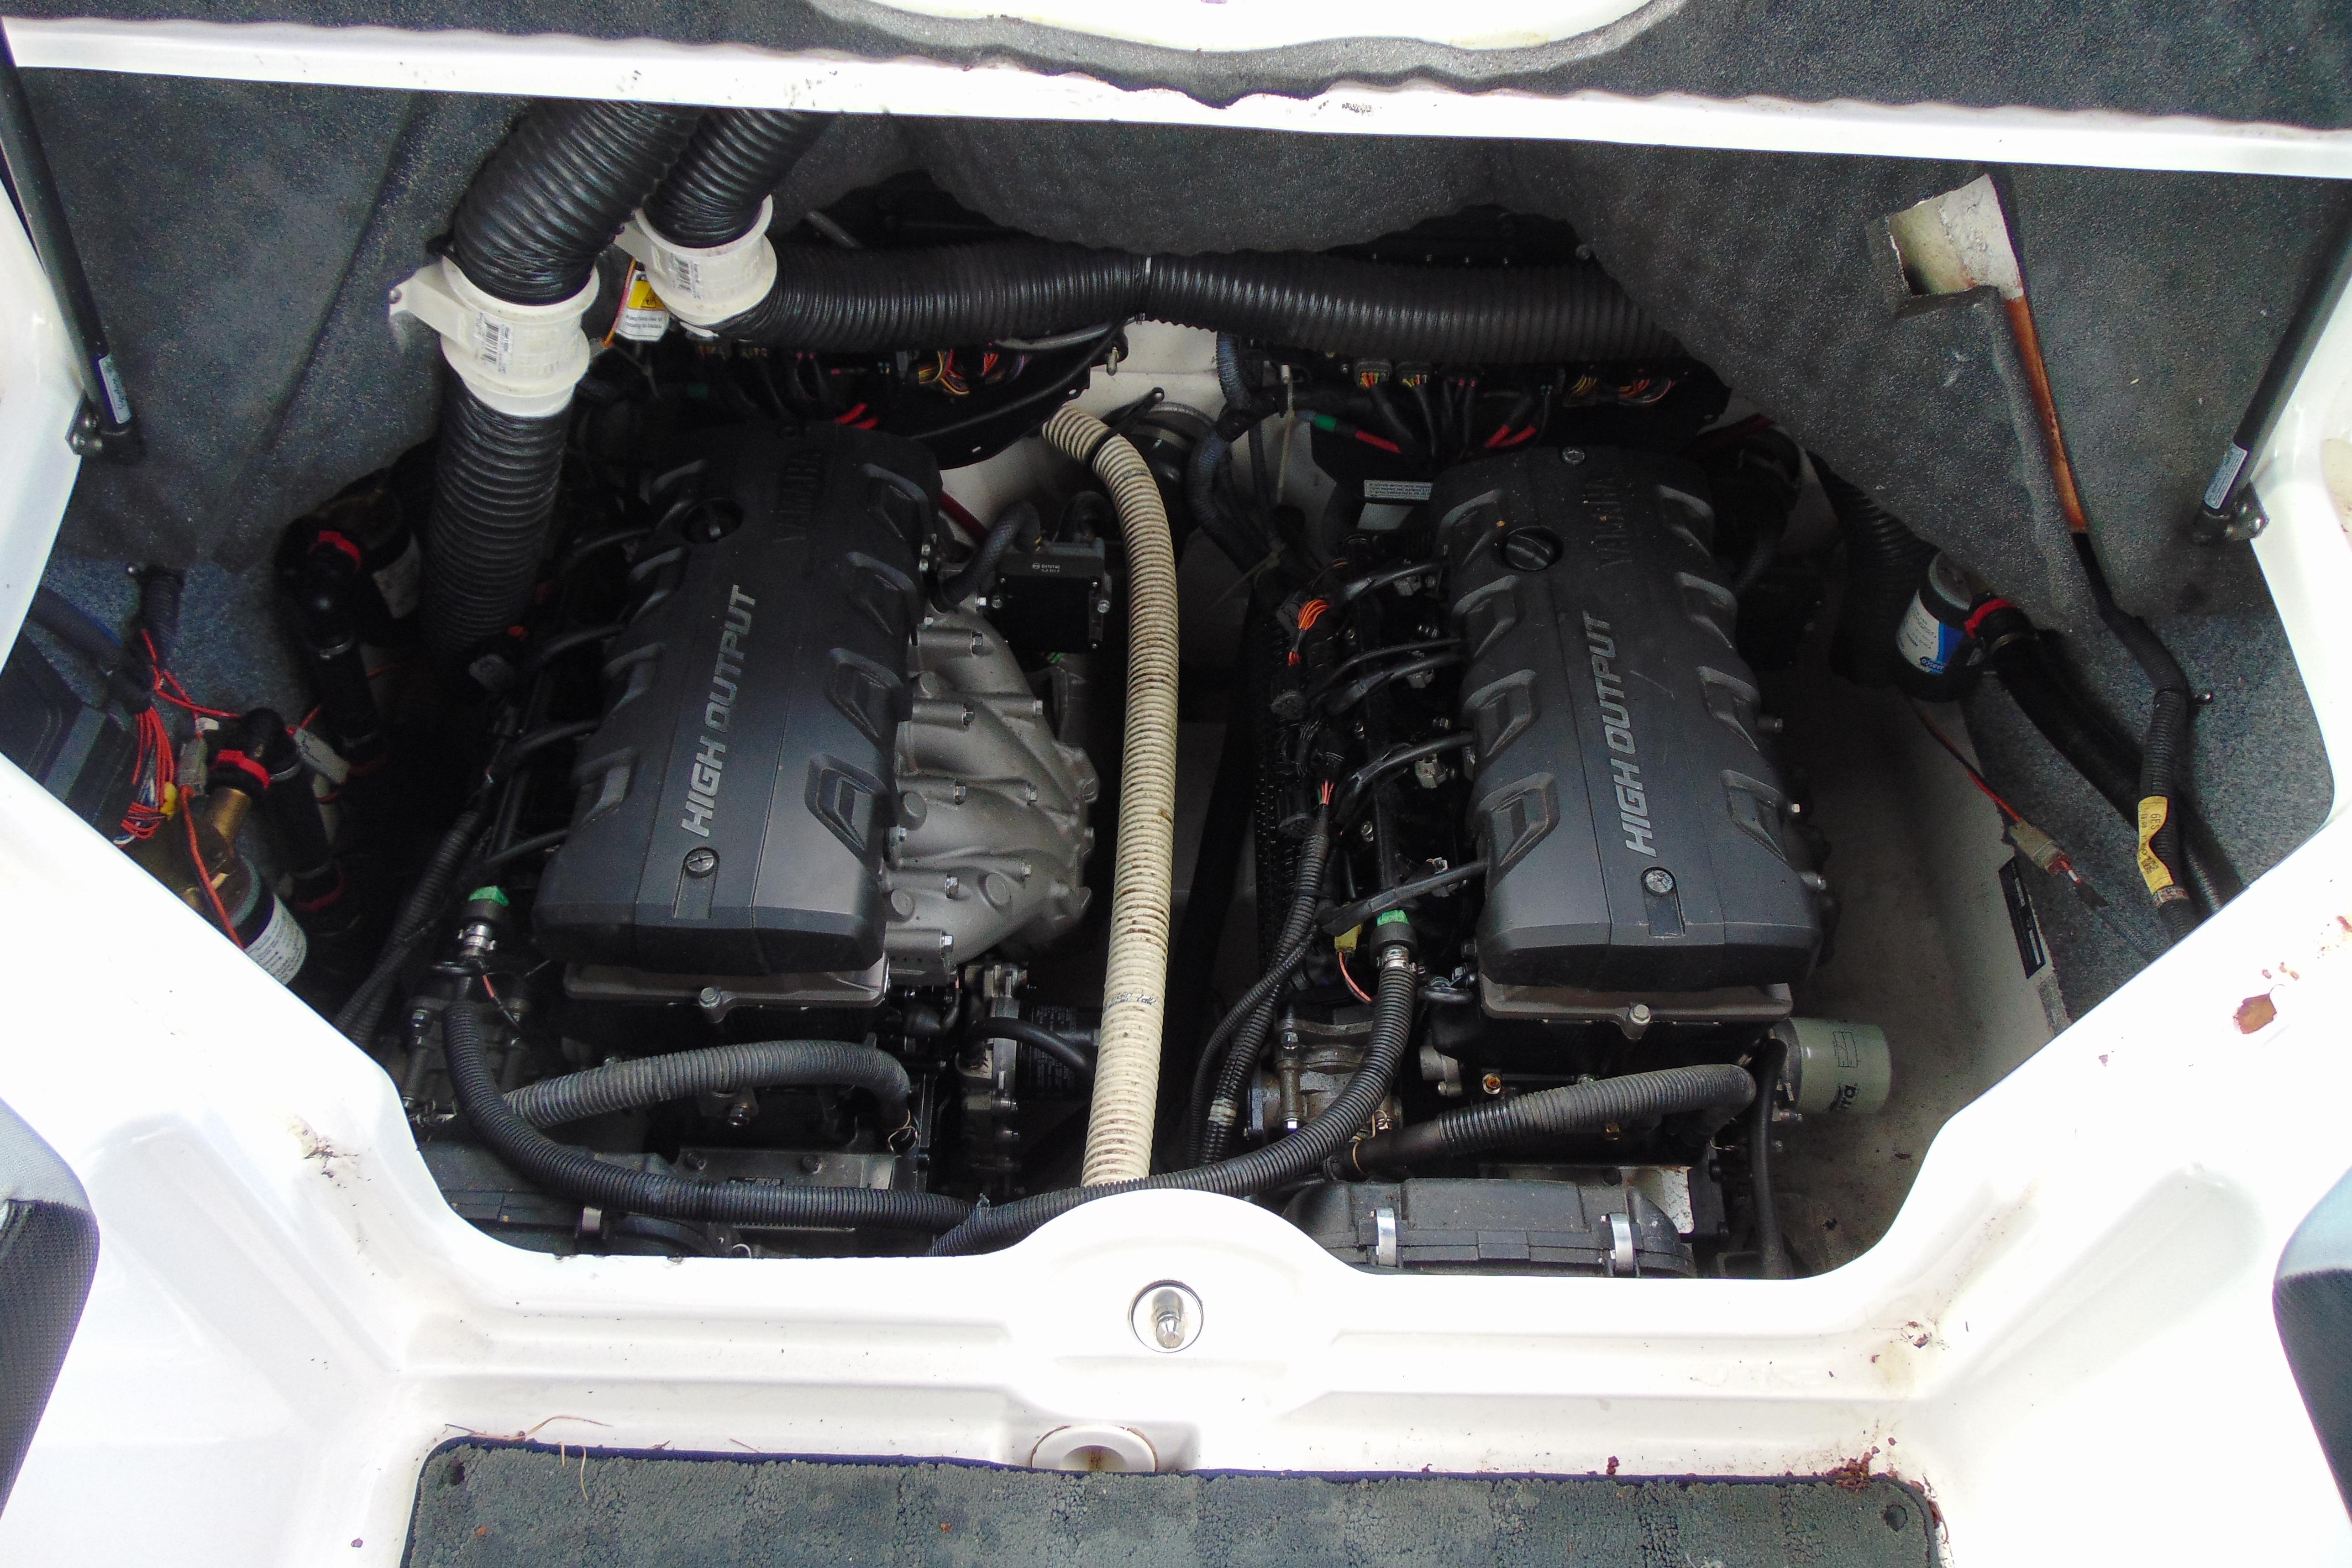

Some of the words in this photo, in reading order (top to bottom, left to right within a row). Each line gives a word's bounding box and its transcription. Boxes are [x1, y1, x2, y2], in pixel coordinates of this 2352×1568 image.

[681, 734, 727, 837] HIGH
[704, 584, 756, 733] OUTPUT
[1583, 610, 1635, 755] OUTPUT
[1611, 758, 1657, 857] HIGH
